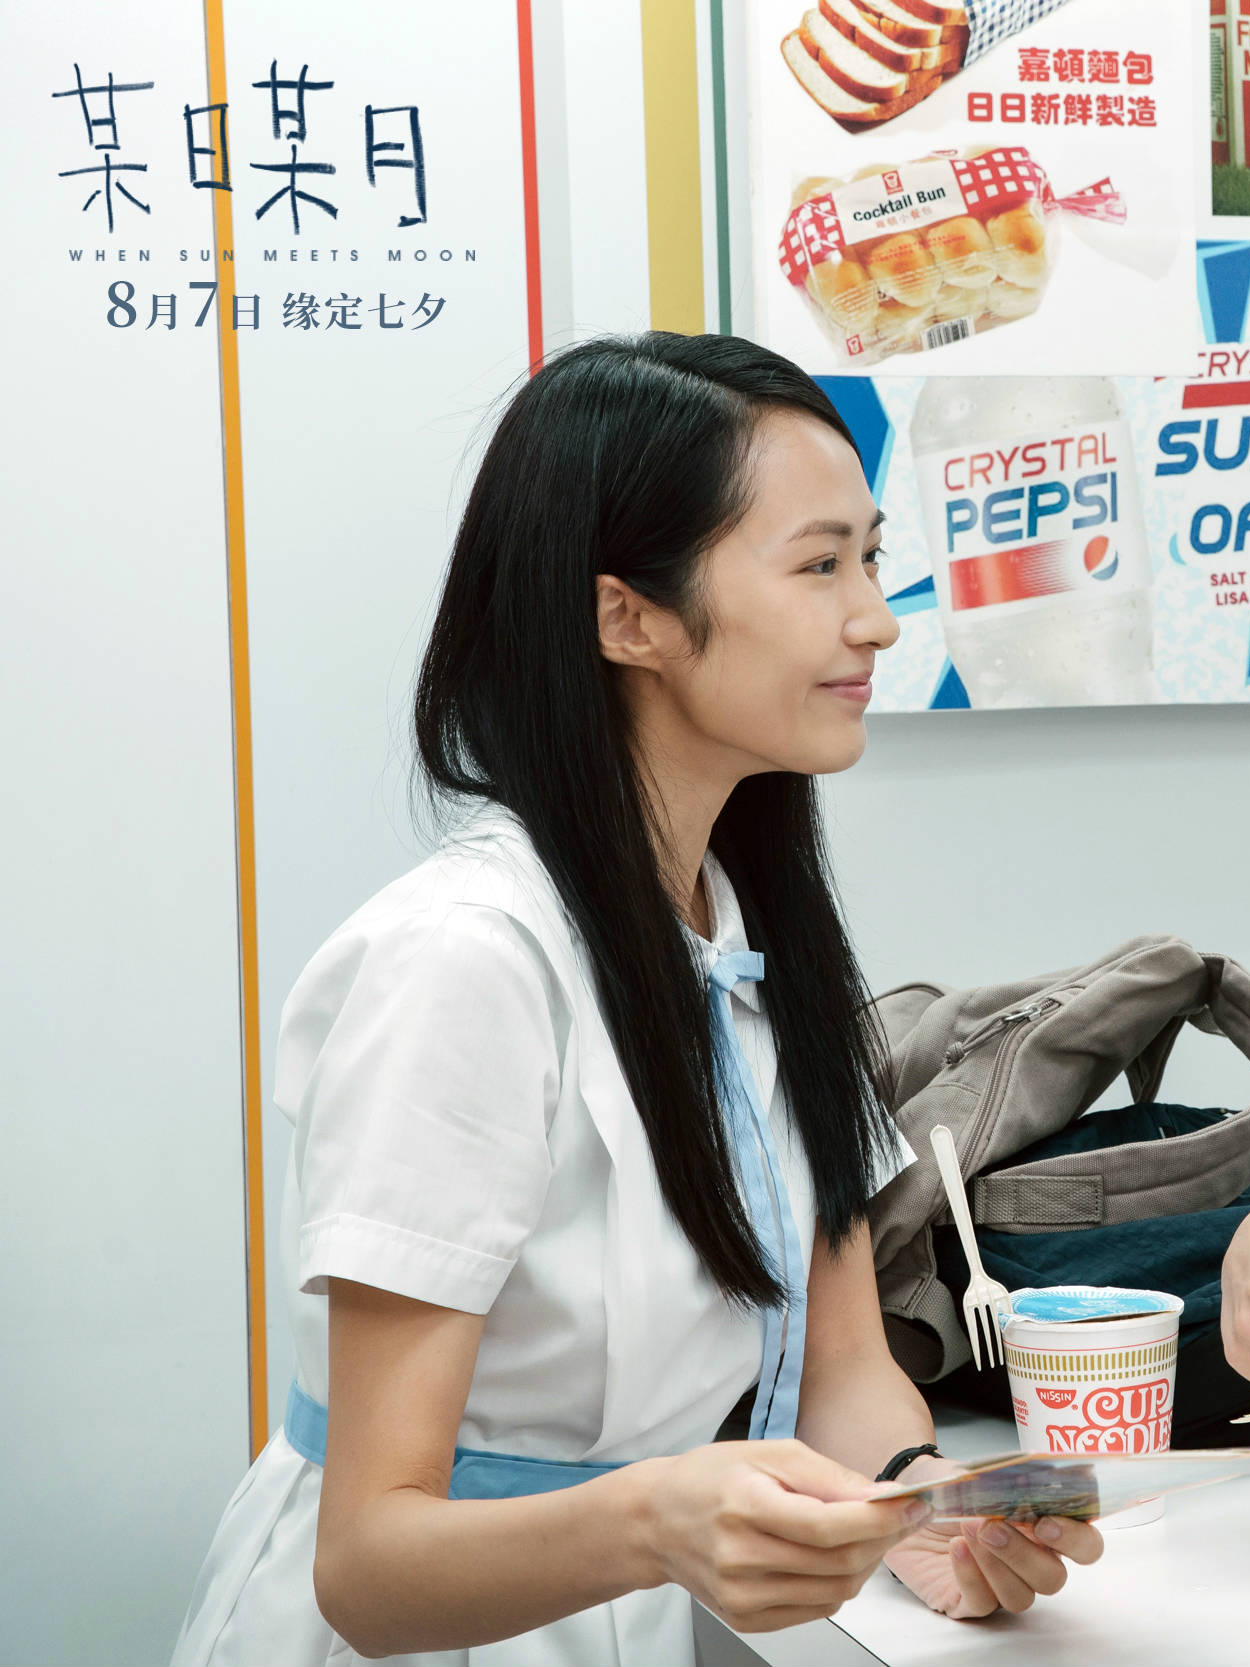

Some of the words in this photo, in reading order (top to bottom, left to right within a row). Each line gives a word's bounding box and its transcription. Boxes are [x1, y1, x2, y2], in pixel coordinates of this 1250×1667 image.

[1018, 47, 1154, 85] 嘉頓麵包
[967, 92, 1157, 127] 日日新鮮製造
[853, 194, 913, 221] Cocktail
[916, 187, 946, 203] Bun
[944, 433, 1117, 492] CRYSTAL
[946, 471, 1119, 554] PEPSI
[1210, 571, 1247, 587] SALT
[1216, 592, 1249, 606] LISA
[1040, 1391, 1072, 1403] NISSIN
[1083, 1380, 1172, 1428] CUP
